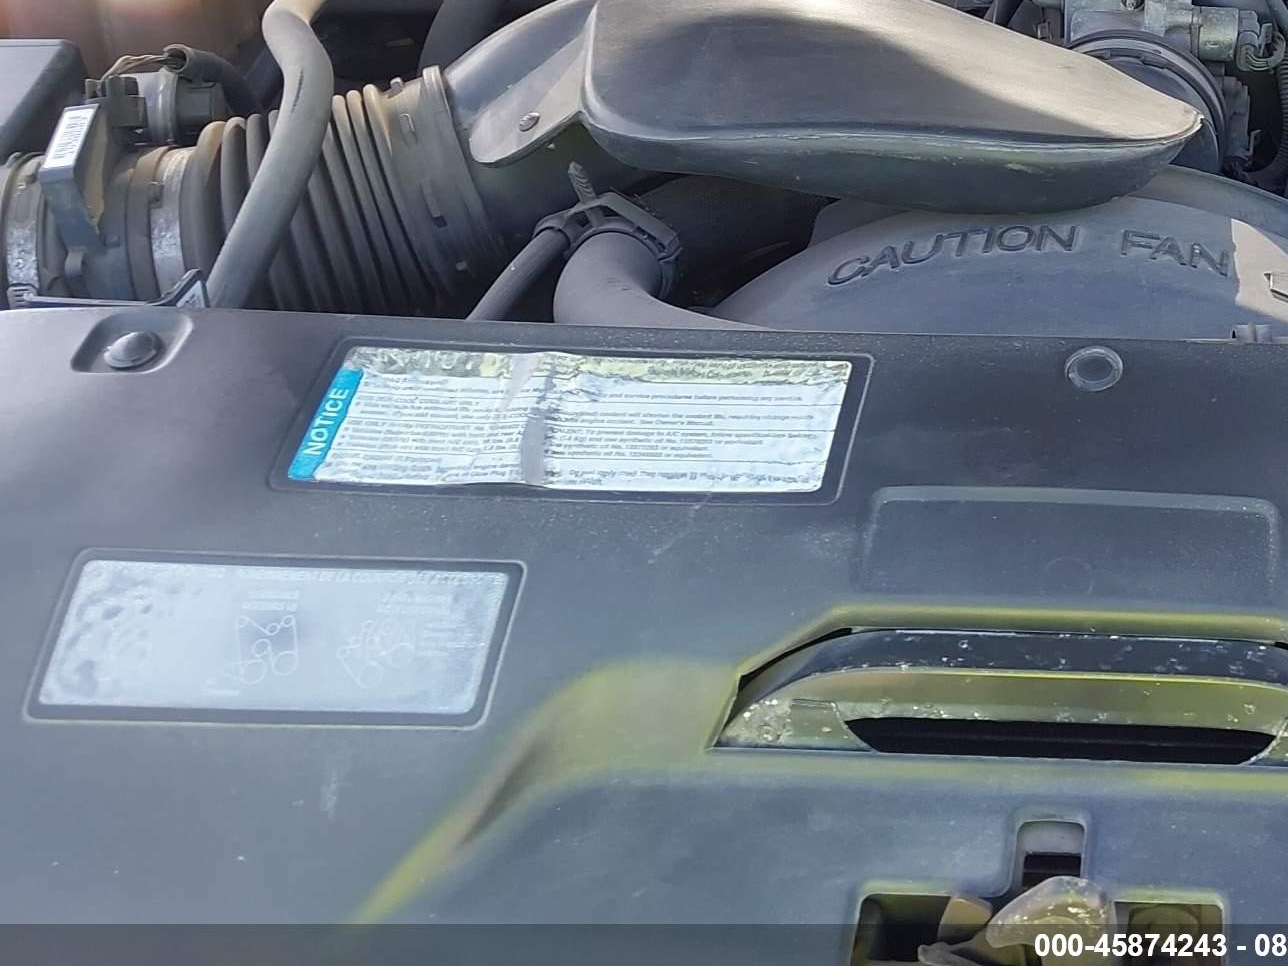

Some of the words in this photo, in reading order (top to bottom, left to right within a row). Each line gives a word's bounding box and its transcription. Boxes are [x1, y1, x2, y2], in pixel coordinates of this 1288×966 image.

[826, 223, 1079, 286] CAUTION
[1121, 228, 1232, 276] FAN
[302, 387, 350, 457] NOTICE
